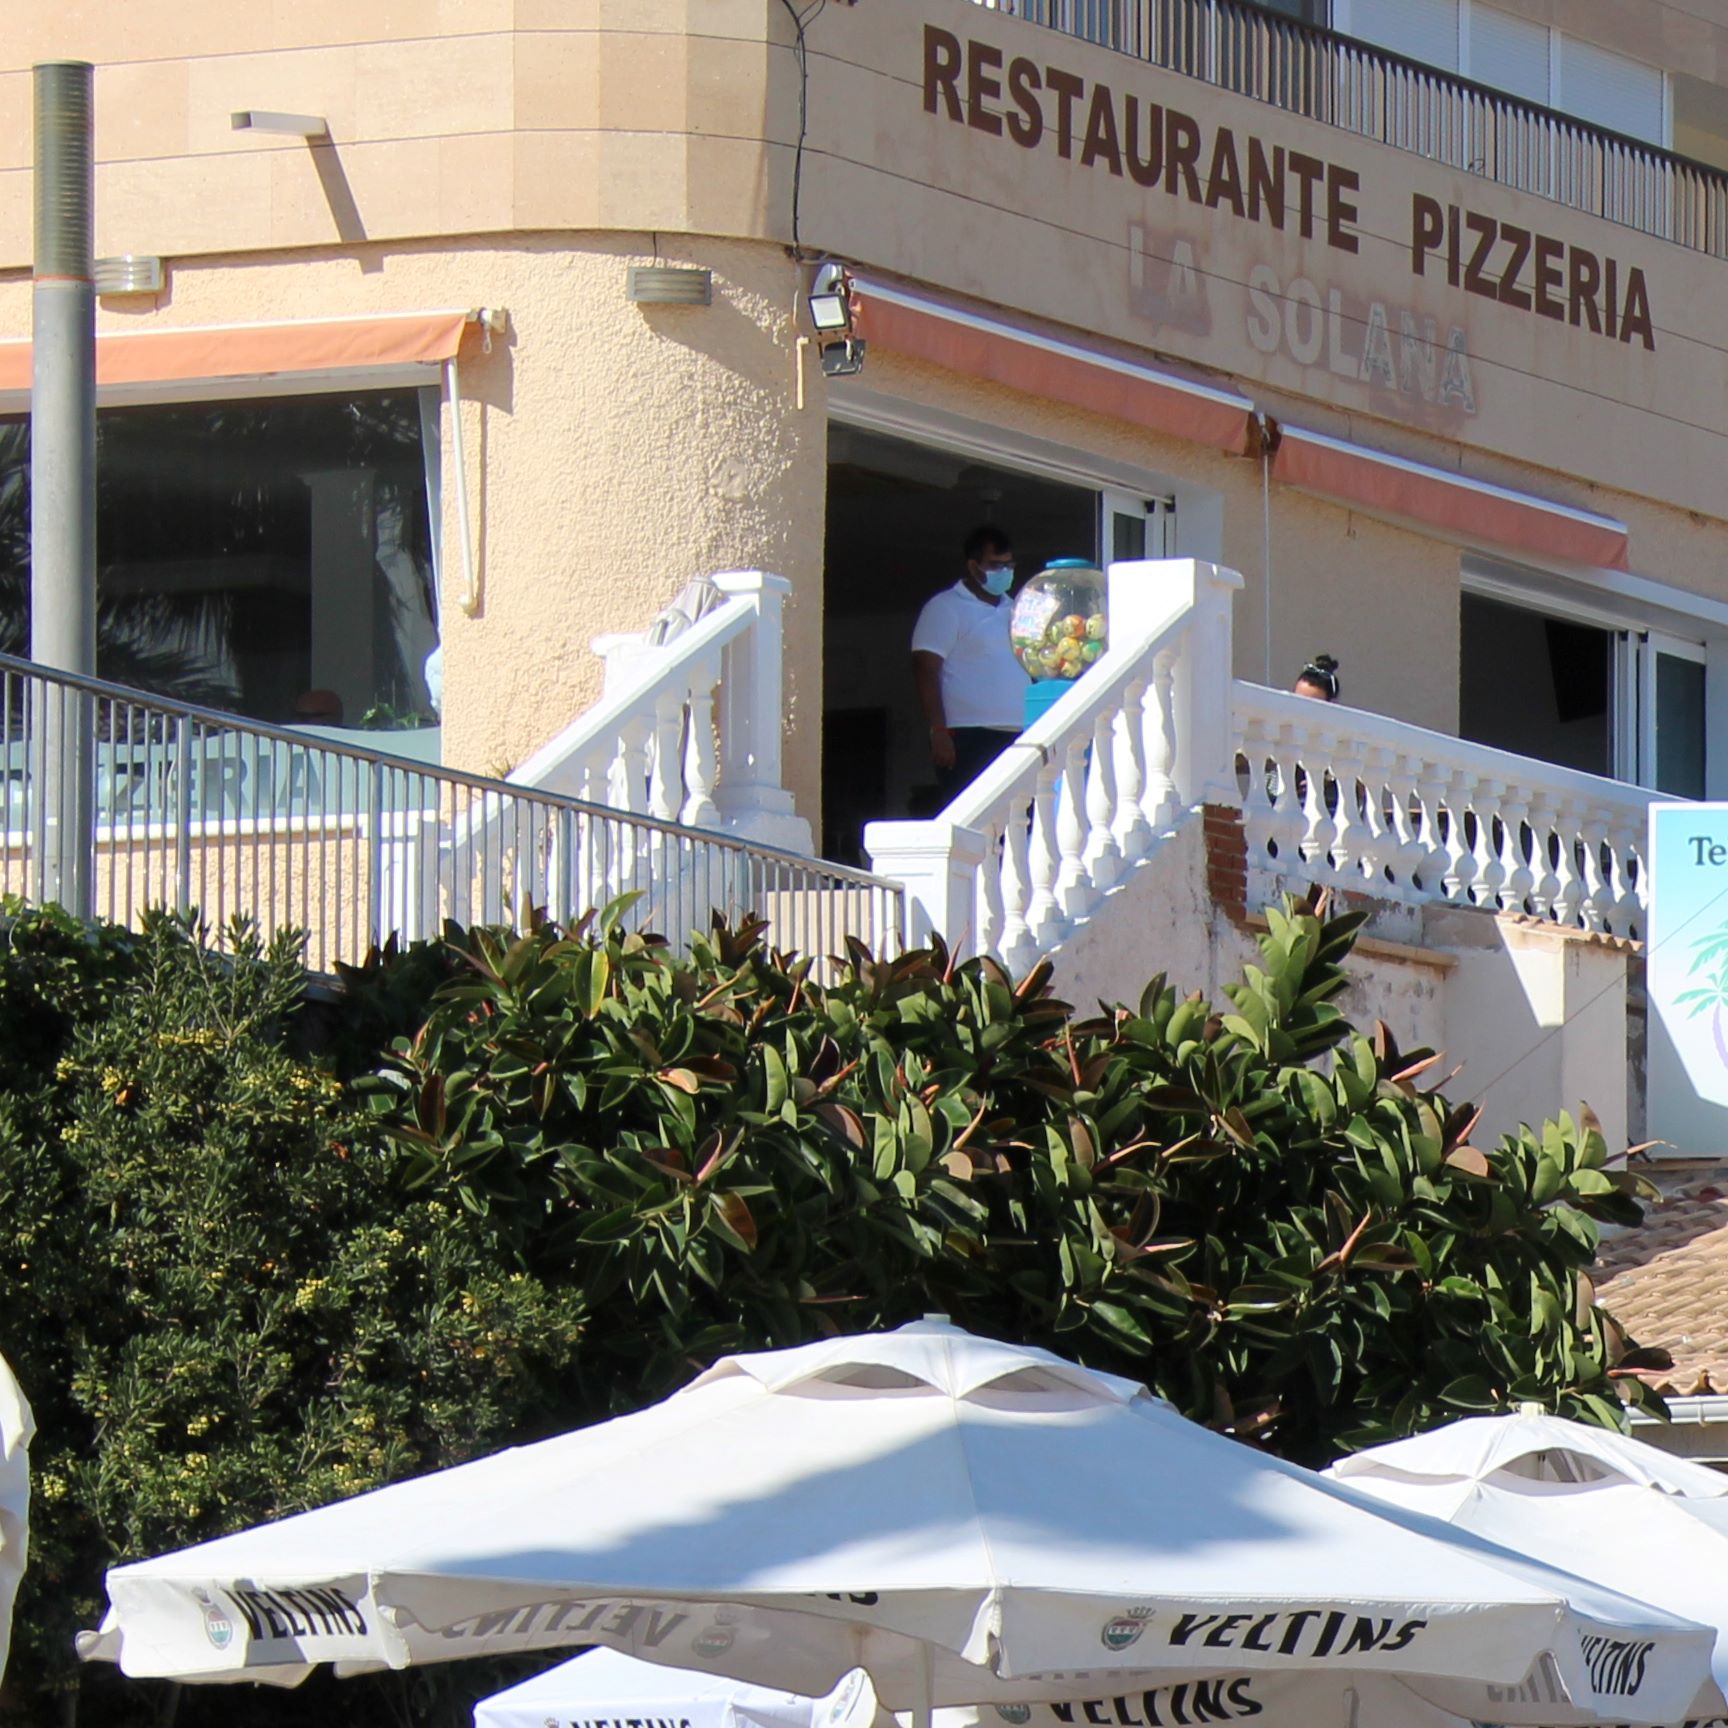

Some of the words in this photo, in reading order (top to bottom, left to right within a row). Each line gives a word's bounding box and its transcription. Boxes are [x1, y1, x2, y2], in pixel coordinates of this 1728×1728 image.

[924, 23, 1360, 255] RESTAURANTE
[1411, 192, 1656, 352] PIZZERIA
[1246, 263, 1477, 416] SOLANA
[222, 1586, 368, 1640] VELTINS
[1170, 1609, 1428, 1657] VELTINS
